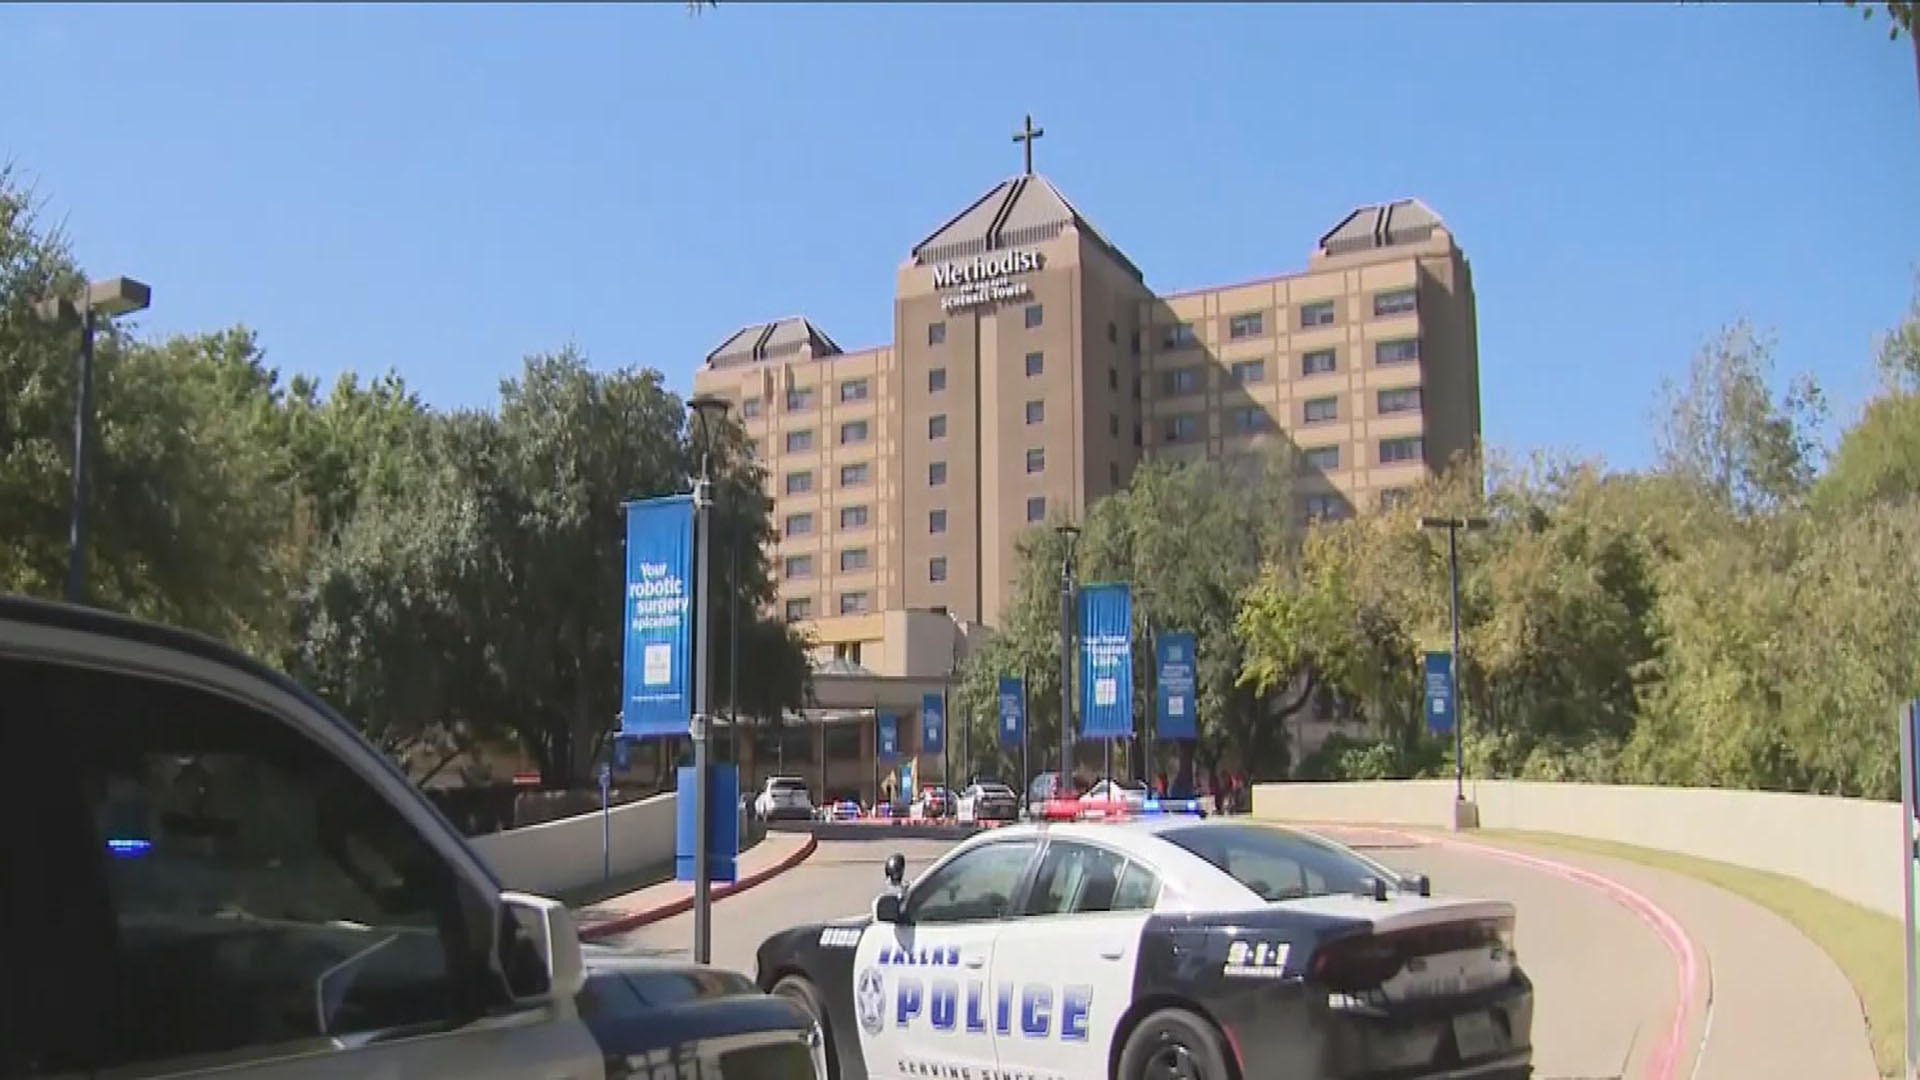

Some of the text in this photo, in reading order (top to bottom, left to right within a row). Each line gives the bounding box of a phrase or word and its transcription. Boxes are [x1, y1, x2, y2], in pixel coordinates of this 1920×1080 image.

[932, 248, 1039, 287] Methodist
[640, 562, 667, 579] Your
[630, 576, 682, 599] robotic
[637, 597, 688, 615] surgery
[878, 944, 961, 965] DALLAS
[896, 977, 1093, 1041] POLICE
[898, 1059, 971, 1080] SERVING
